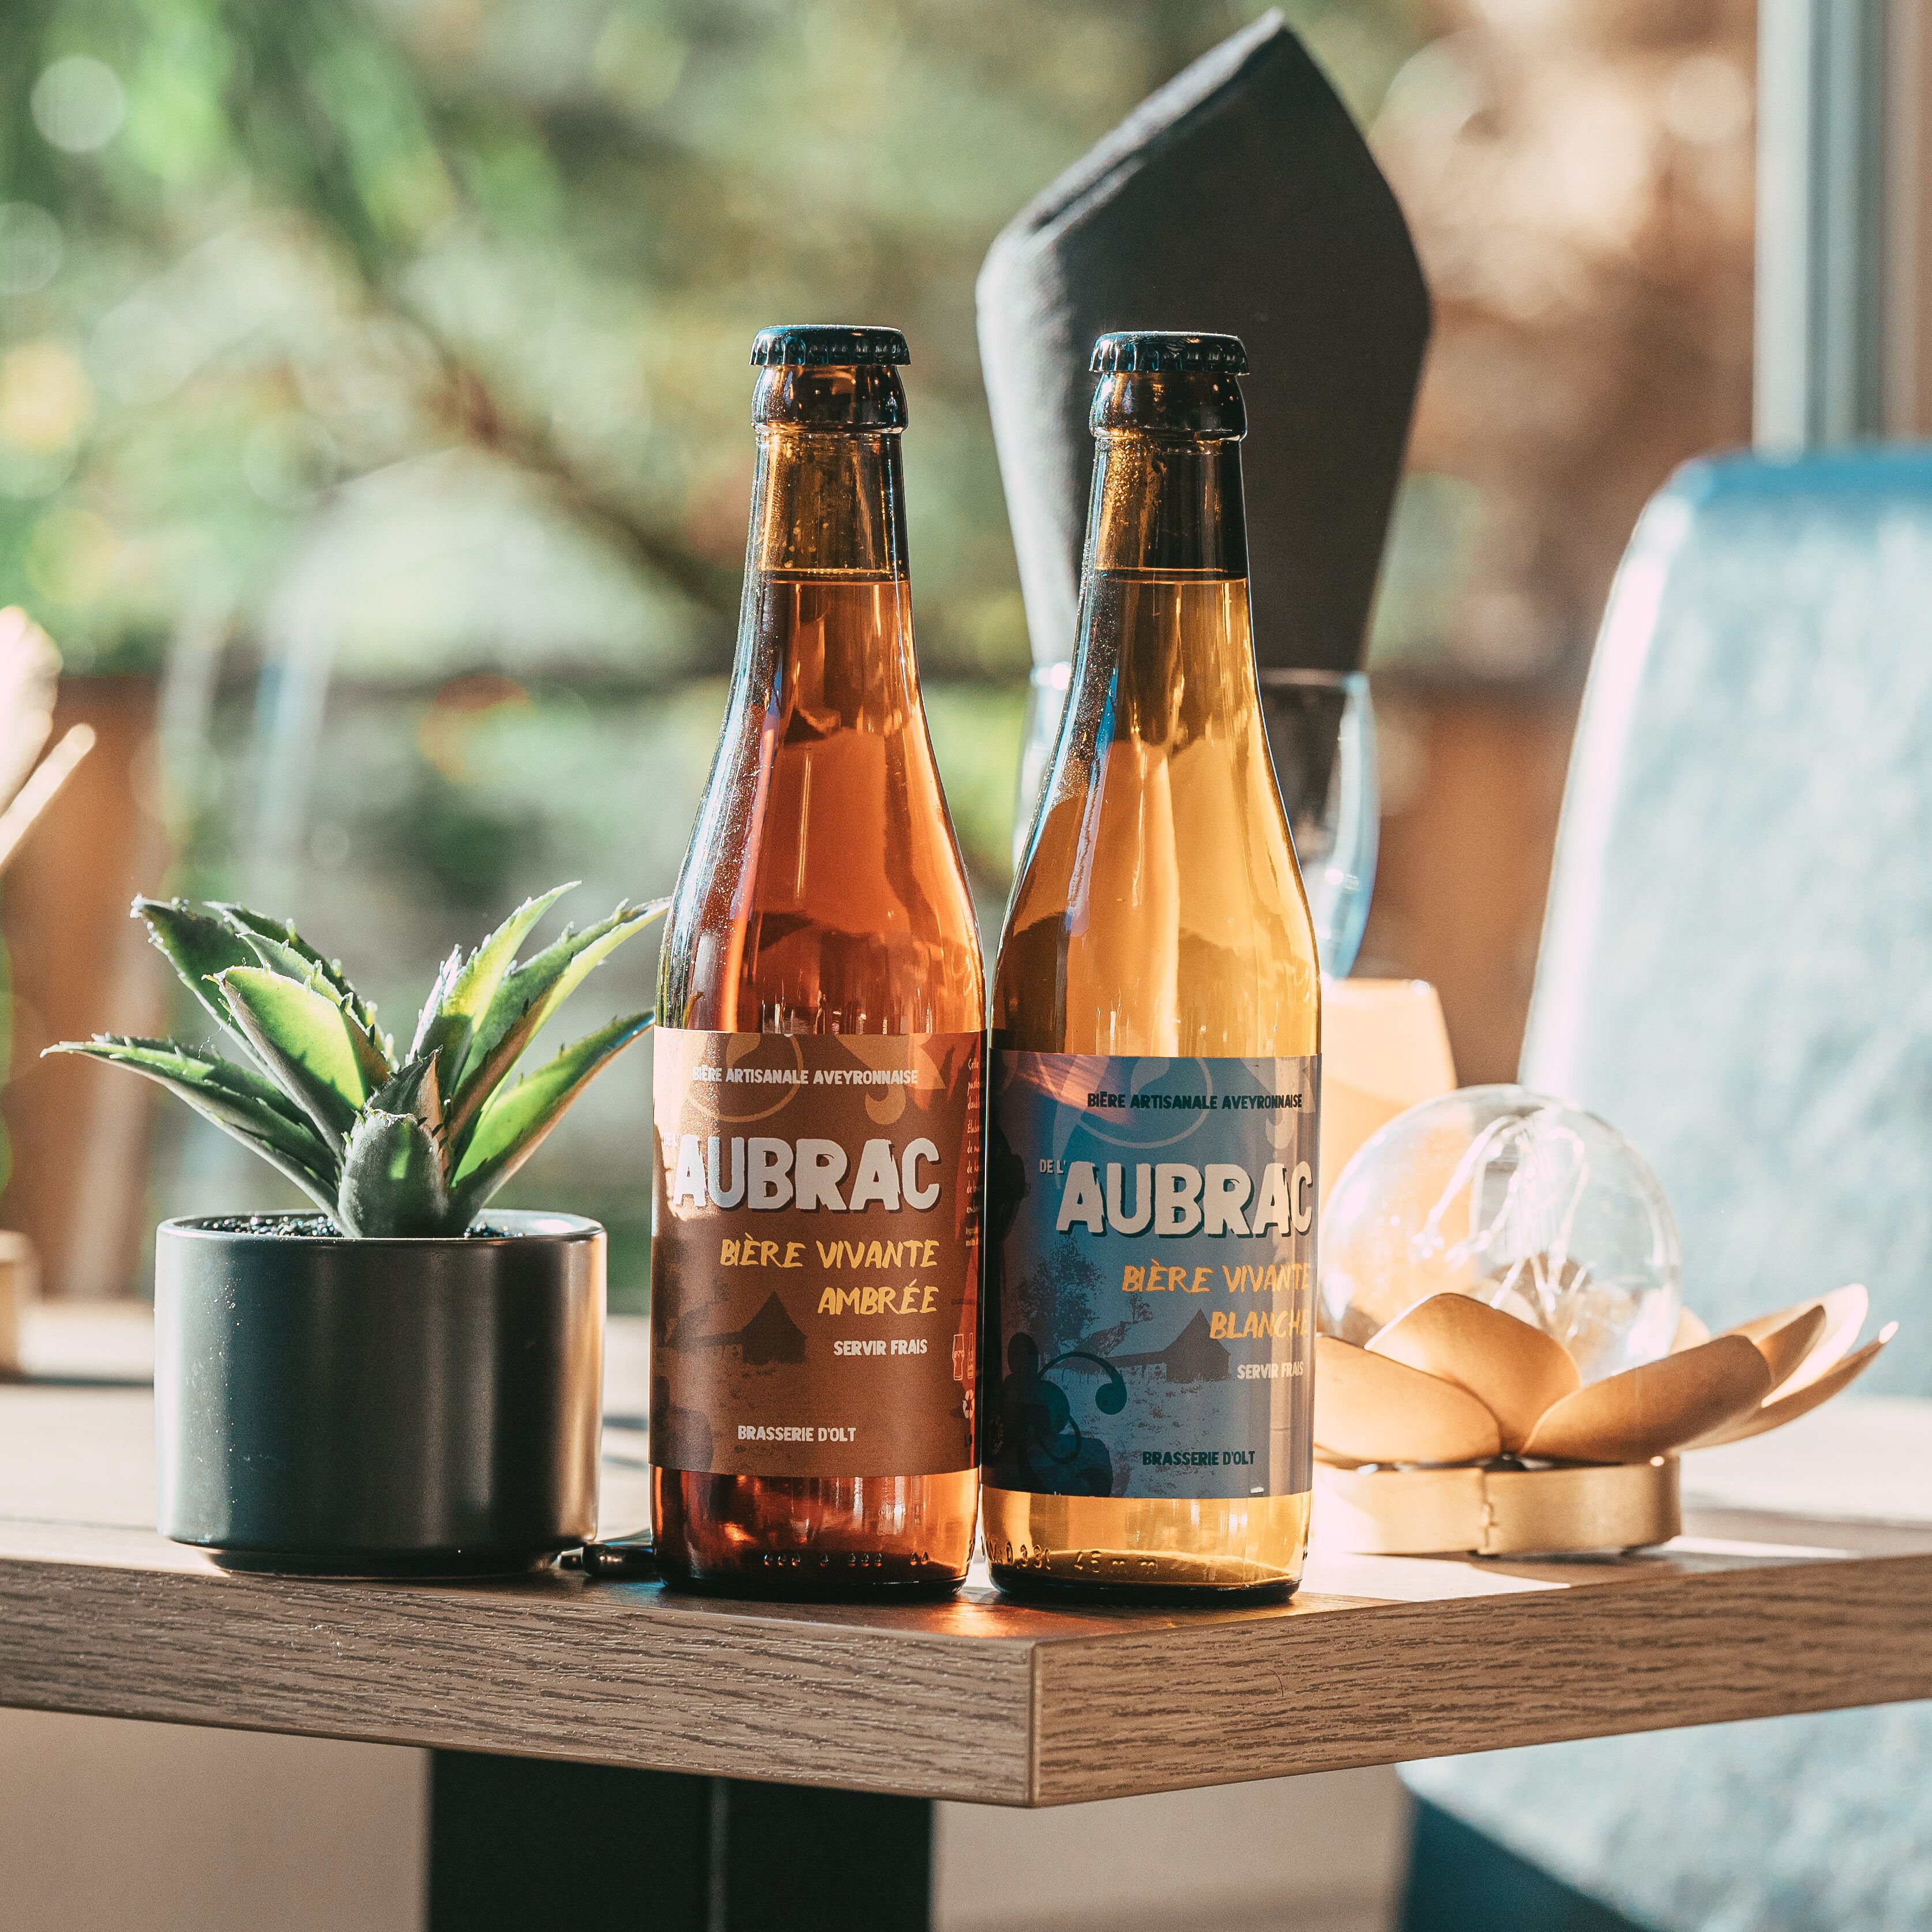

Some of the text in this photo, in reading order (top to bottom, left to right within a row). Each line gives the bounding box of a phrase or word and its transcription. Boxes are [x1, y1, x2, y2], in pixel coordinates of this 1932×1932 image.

[692, 1066, 918, 1085] BIÈRE ARTISANALE AVEYRONNAISE
[1088, 1091, 1302, 1110] BIÈRE ARTISANALE AVEYRONNAISE
[673, 1135, 941, 1213] AUBRAC
[1039, 1159, 1054, 1174] DE
[1056, 1160, 1313, 1238] AUBRAC
[720, 1232, 939, 1269] BIÈRE VIVANTE
[1121, 1257, 1309, 1294] BIÈRE VIVANTE
[817, 1278, 939, 1315] AMBRÉE
[1209, 1310, 1309, 1339] BLANCHE
[833, 1339, 927, 1355] SERVIR FRAIS
[1236, 1361, 1304, 1379] SERVIR FRAIS
[738, 1425, 856, 1442] BRASSERIE D'OLT
[1142, 1450, 1256, 1465] BRASSERIE D'OLT
